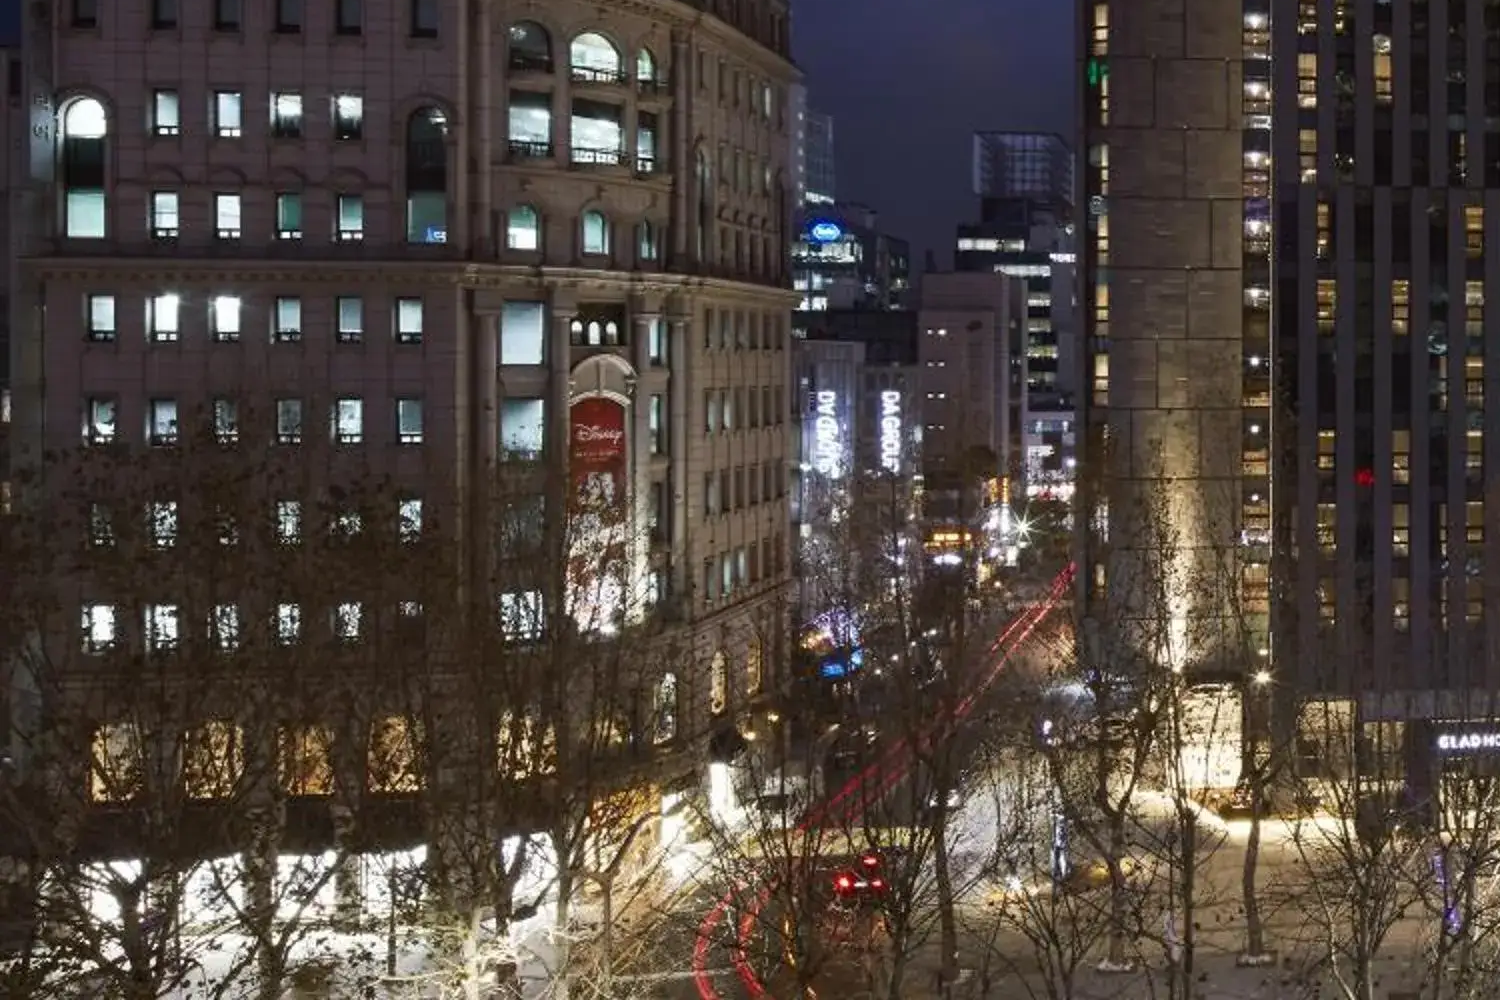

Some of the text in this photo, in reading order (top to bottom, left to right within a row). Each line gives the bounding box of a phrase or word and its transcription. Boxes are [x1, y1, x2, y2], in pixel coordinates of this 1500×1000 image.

[881, 390, 901, 416] DA
[575, 423, 624, 446] Disney
[1438, 733, 1481, 750] GLAD
